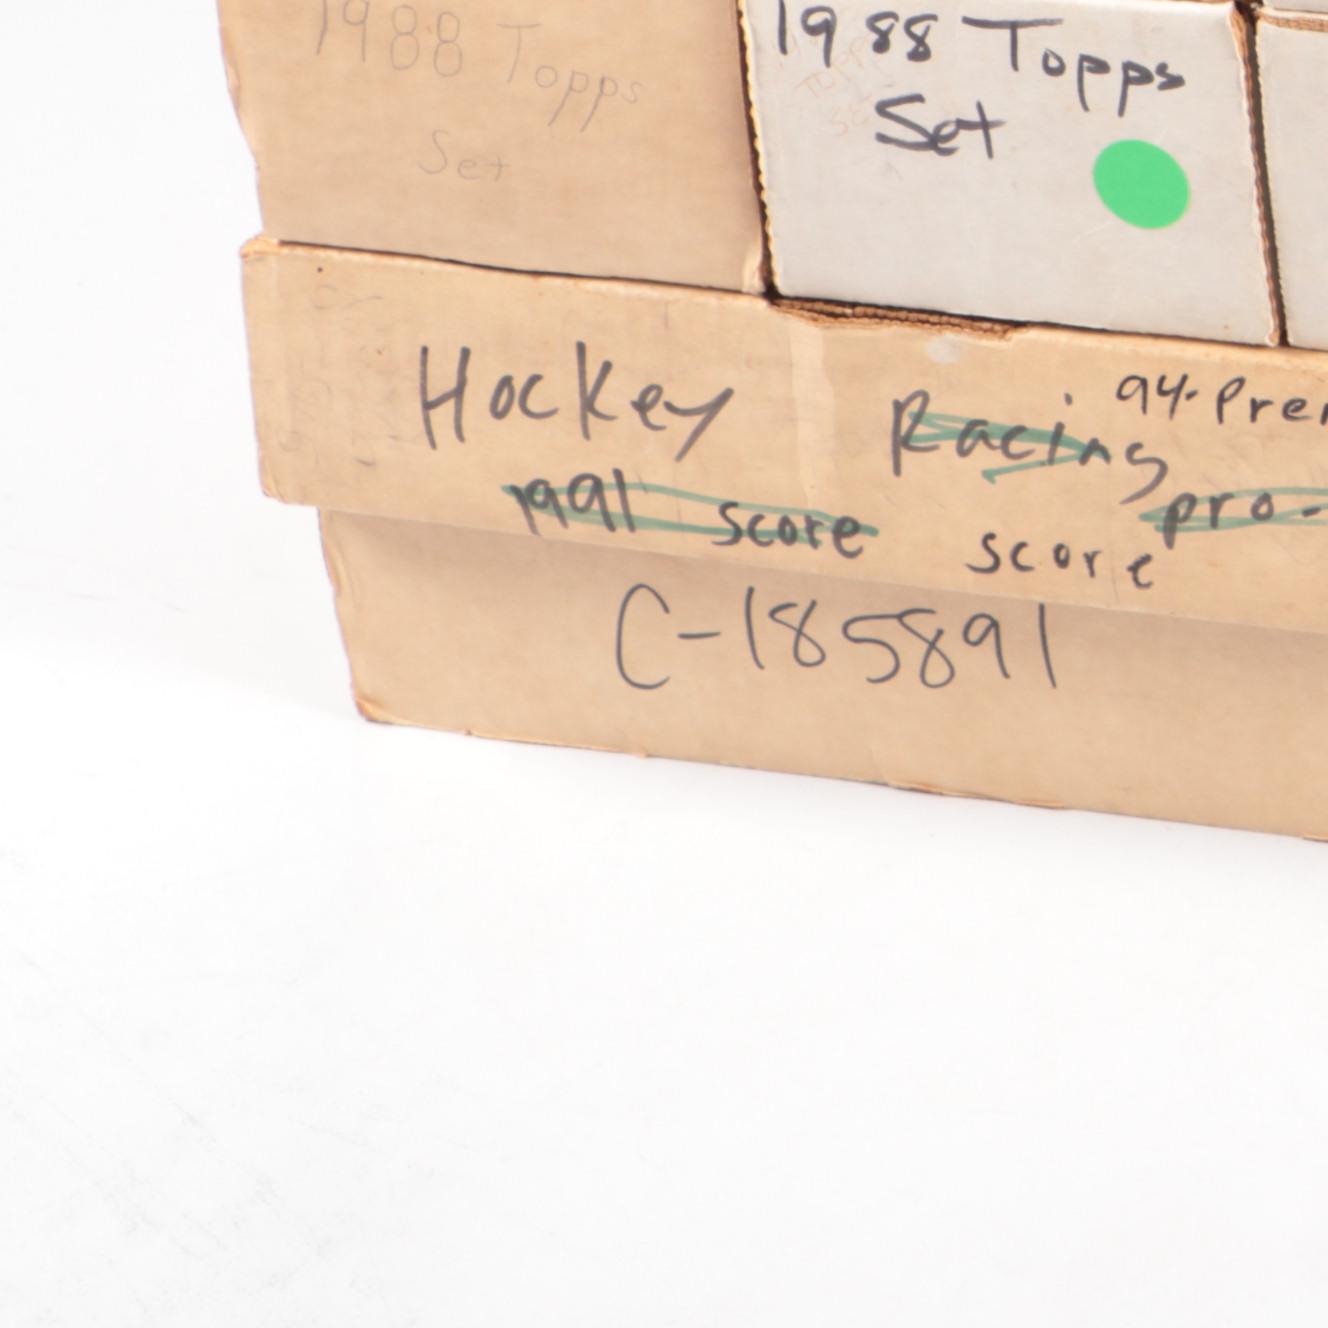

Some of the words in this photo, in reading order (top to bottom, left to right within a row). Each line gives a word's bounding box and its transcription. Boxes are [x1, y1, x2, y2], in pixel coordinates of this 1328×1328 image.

[498, 23, 643, 133] Topps
[961, 16, 1186, 118] Topps
[418, 130, 510, 181] Set
[875, 93, 1006, 159] Set
[614, 583, 1056, 690] C-185891
